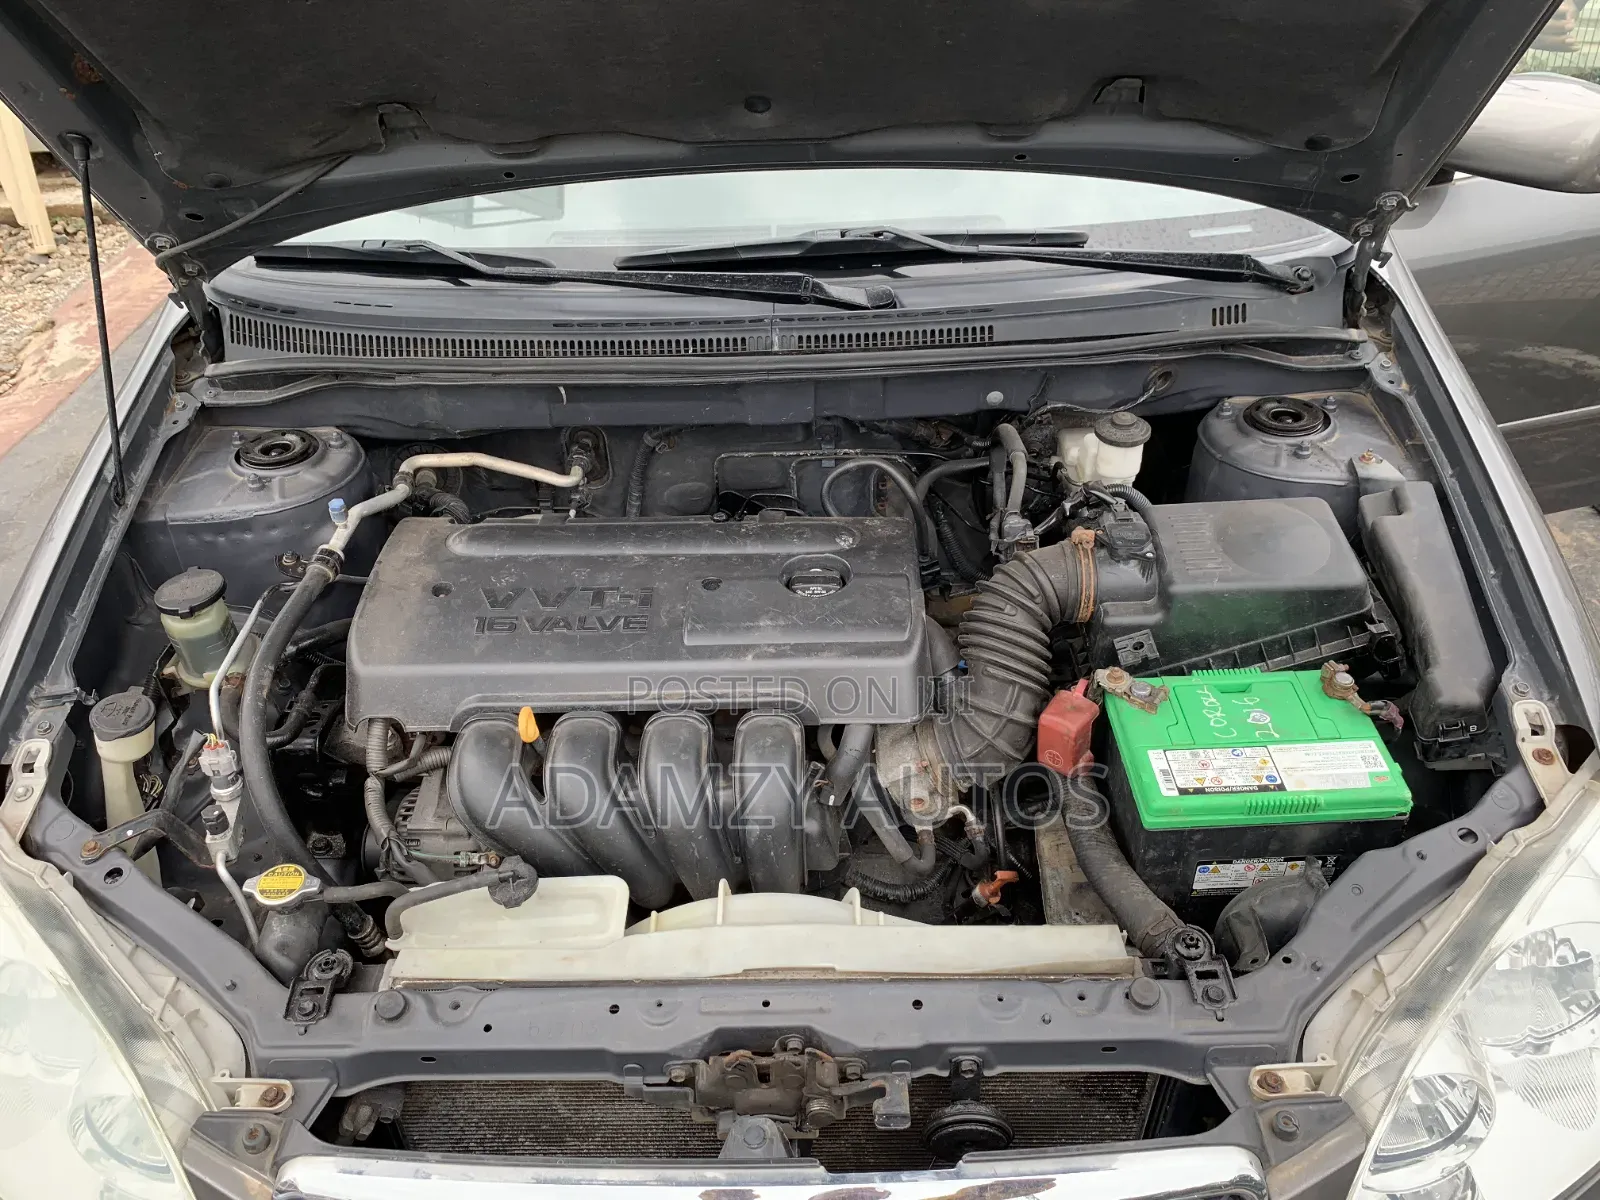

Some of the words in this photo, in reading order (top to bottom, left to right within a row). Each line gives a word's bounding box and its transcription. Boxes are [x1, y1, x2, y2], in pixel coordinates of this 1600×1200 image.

[474, 616, 518, 635] 16
[522, 615, 649, 635] VALVE
[1232, 697, 1280, 738] 2016
